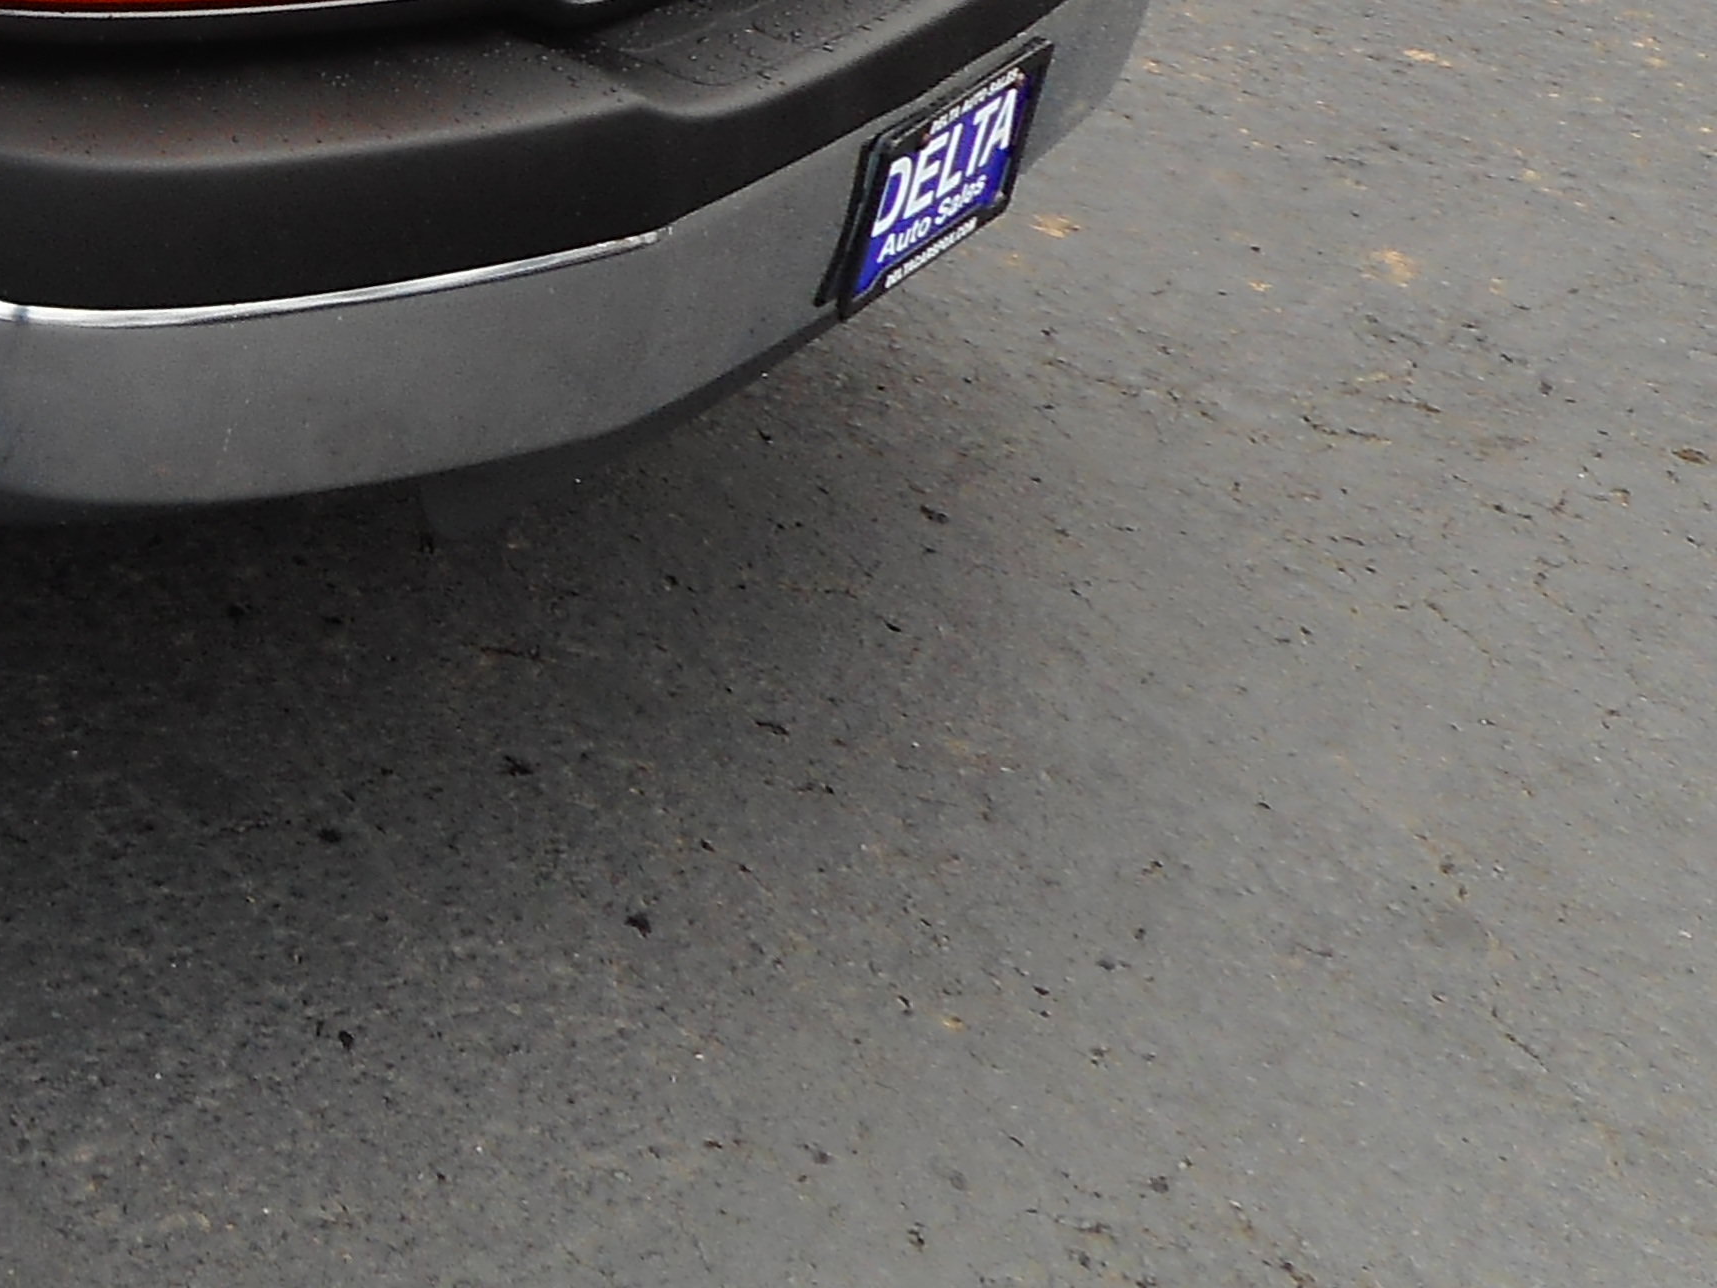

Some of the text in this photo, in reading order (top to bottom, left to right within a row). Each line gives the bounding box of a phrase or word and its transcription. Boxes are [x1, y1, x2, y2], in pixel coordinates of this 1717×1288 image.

[871, 88, 1018, 238] DELTA
[876, 174, 988, 263] Auto Sales
